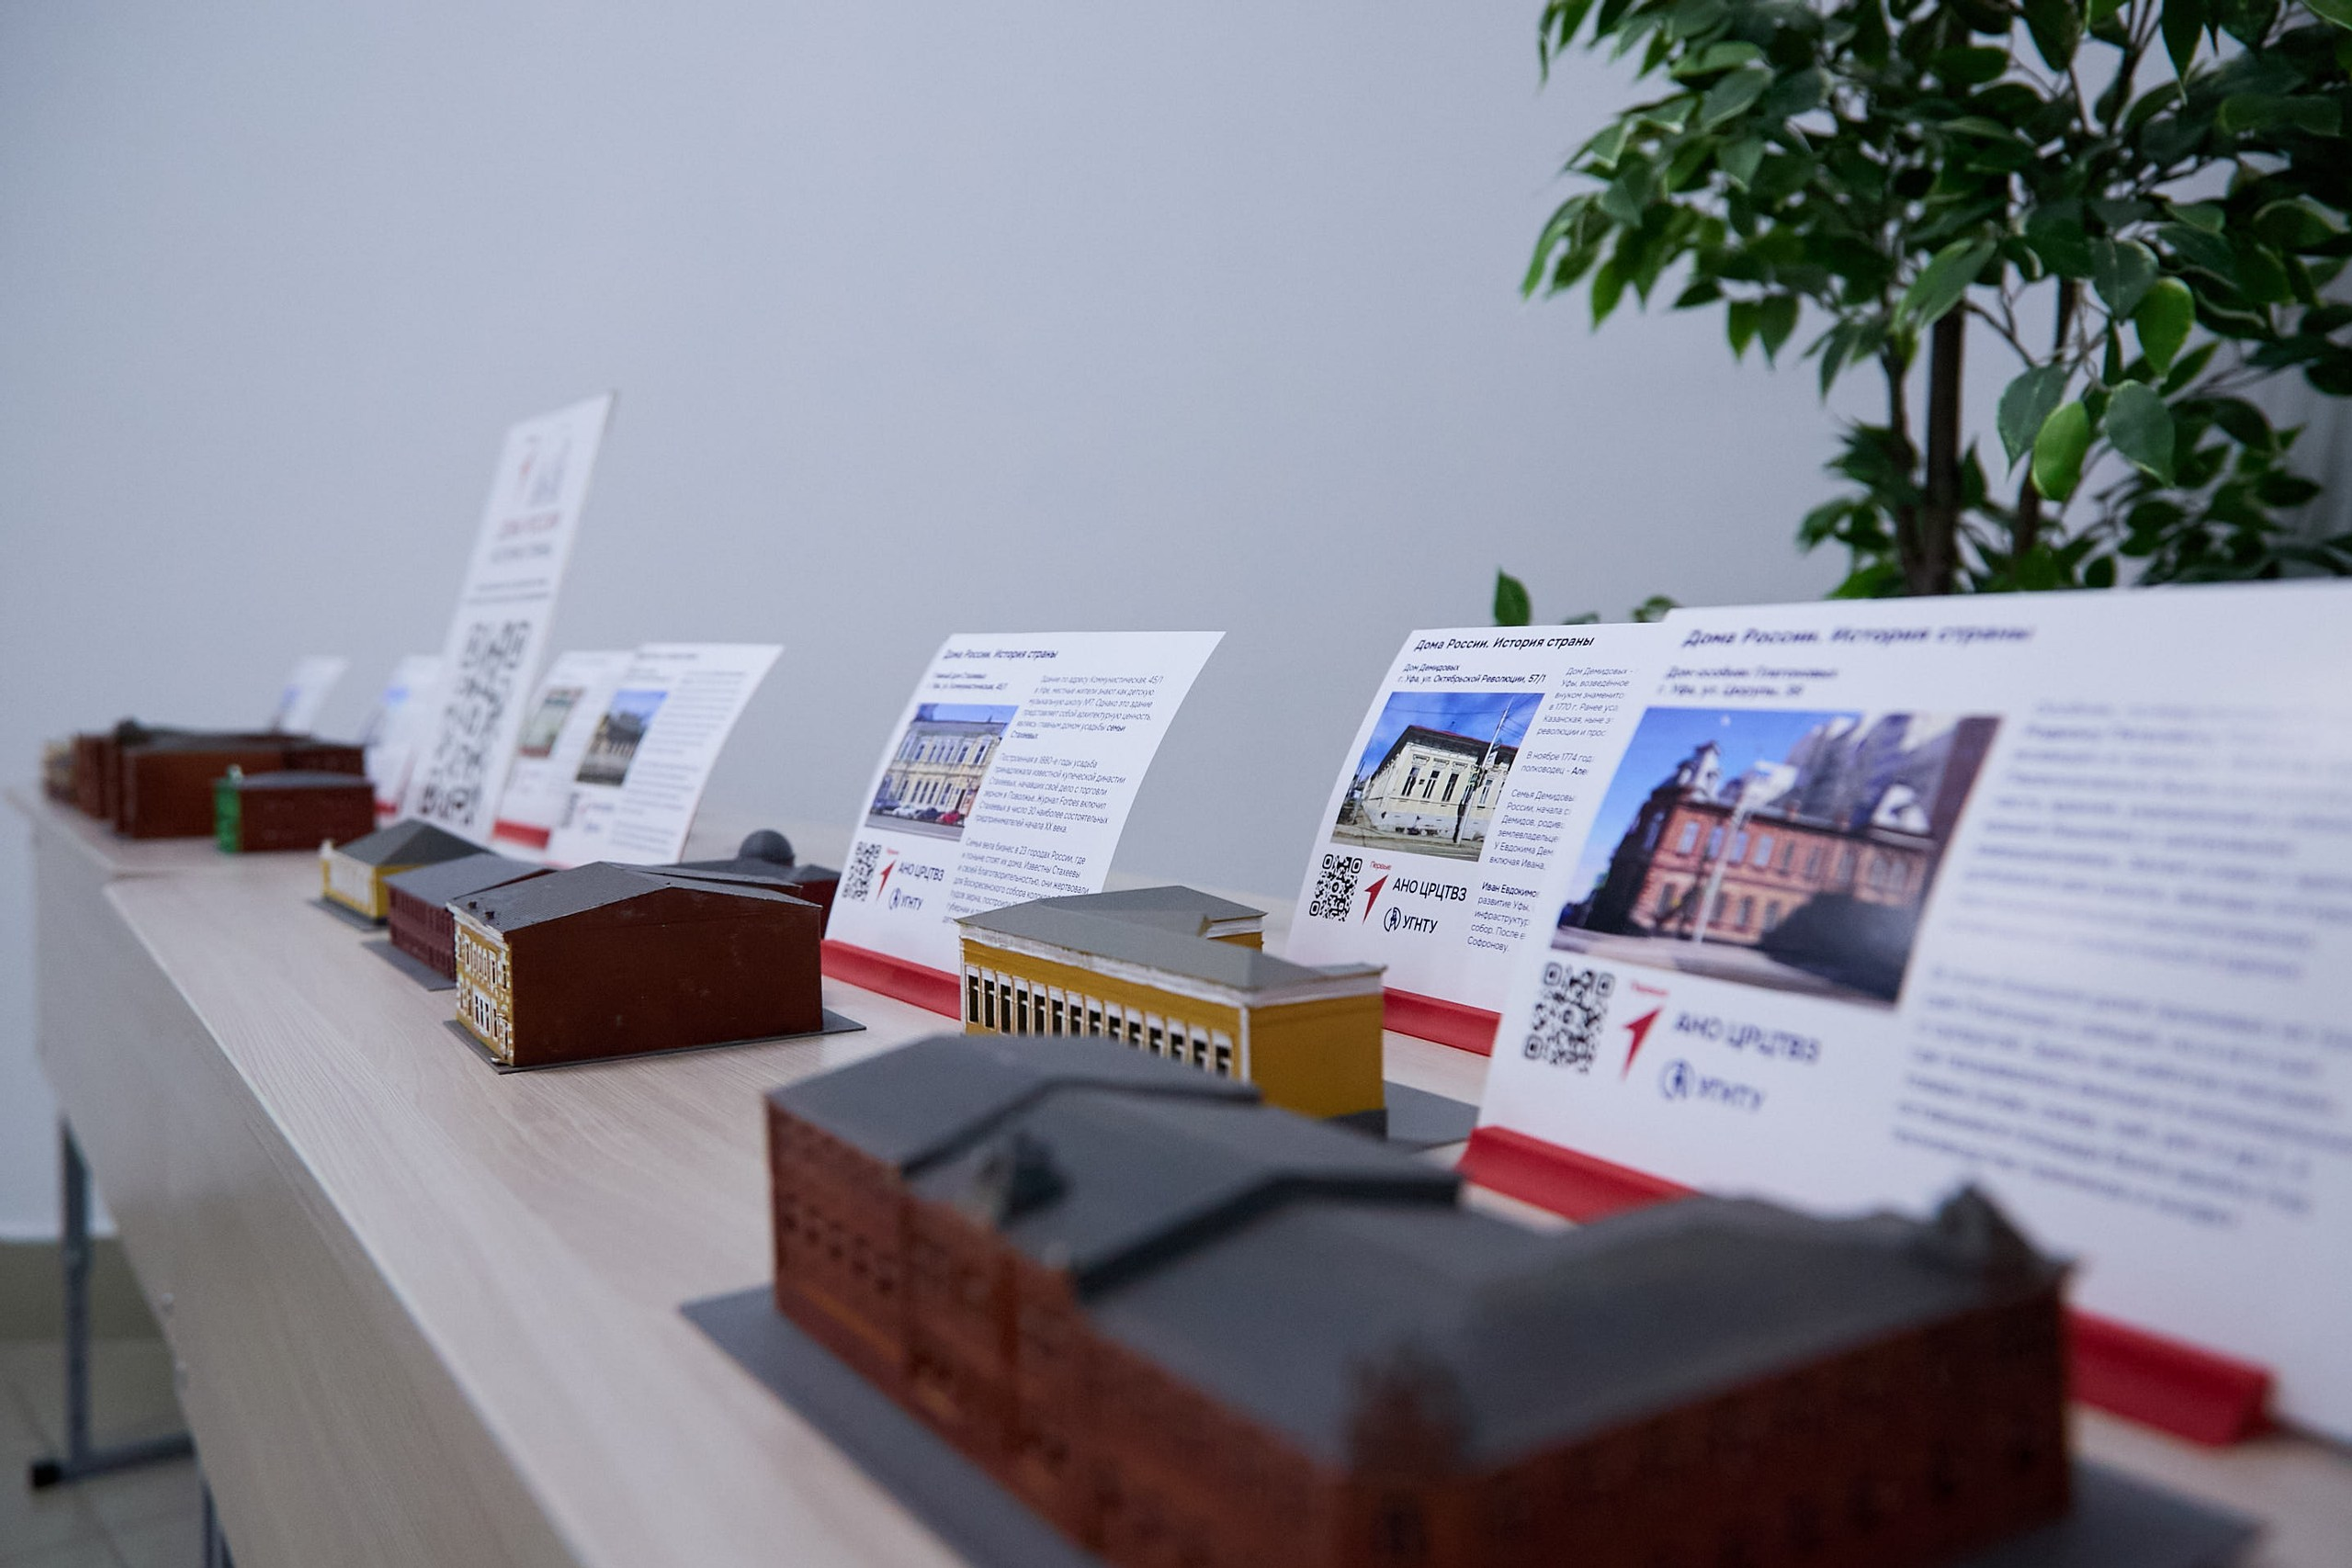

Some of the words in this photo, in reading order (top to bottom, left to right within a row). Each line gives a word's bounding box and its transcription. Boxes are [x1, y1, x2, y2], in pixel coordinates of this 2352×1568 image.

[1414, 639, 1444, 651] Дома
[1446, 638, 1488, 649] России.
[1492, 637, 1545, 650] История
[1546, 637, 1595, 649] страны
[994, 649, 1027, 660] История
[1027, 650, 1058, 660] страны
[1404, 663, 1419, 671] Дом
[1419, 663, 1460, 672] Демидовых
[1566, 667, 1582, 676] Дом
[1583, 667, 1628, 675] Демидовых
[1407, 675, 1419, 683] Уфа,
[1421, 676, 1431, 684] ул.
[1433, 674, 1481, 684] Октябрьской
[1482, 674, 1525, 684] Революции,
[1527, 674, 1546, 684] 57/1
[1126, 689, 1155, 697] детскую
[1555, 693, 1582, 701] внуком
[1095, 698, 1118, 707] Однако
[1555, 703, 1571, 711] 1770
[1579, 703, 1603, 711] Ранее
[1077, 711, 1122, 721] архитектурную
[1587, 729, 1607, 738] прос
[1526, 751, 1532, 760] В
[1533, 751, 1560, 761] ноябре
[1561, 752, 1577, 761] 1774
[1578, 755, 1594, 763] год
[1073, 760, 1098, 769] усадьба
[1521, 765, 1564, 775] полководец
[1570, 767, 1589, 775] Але
[1032, 769, 1062, 778] известной
[1062, 771, 1096, 782] купеческой
[1095, 775, 1126, 784] династии
[1058, 784, 1073, 794] дело
[1080, 786, 1108, 795] торговли
[1511, 789, 1534, 798] Семья
[1534, 791, 1576, 802] Демидовы
[1059, 797, 1080, 807] Forbes
[1080, 800, 1107, 809] включил
[1507, 802, 1534, 812] России,
[1536, 807, 1563, 815] начала
[1028, 806, 1036, 814] 30
[1036, 807, 1064, 819] наиболее
[1064, 813, 1108, 825] состоятельных
[1501, 815, 1536, 826] Демидов,
[1025, 820, 1045, 830] начала
[1498, 829, 1559, 843] землевладельце
[995, 841, 1014, 853] бизнес
[1020, 845, 1027, 855] 23
[1027, 849, 1050, 860] городах
[1051, 851, 1074, 863] России,
[1074, 855, 1087, 865] где
[1494, 841, 1499, 850] У
[1500, 842, 1535, 854] Евдокима
[1535, 846, 1554, 856] Дем
[899, 863, 914, 874] АНО
[1370, 861, 1392, 870] Первые
[1489, 856, 1520, 866] включая
[1521, 859, 1545, 871] Ивана,
[1023, 862, 1052, 874] Известны
[1052, 865, 1081, 879] Стахеевы
[978, 866, 1040, 886] благотворительностью,
[1040, 879, 1052, 888] они
[1052, 882, 1090, 895] жертвовали
[1482, 881, 1499, 892] Иван
[1006, 886, 1026, 897] собора
[1392, 877, 1419, 894] АНО
[1419, 881, 1467, 901] ЦРЦТВЗ
[900, 896, 924, 910] УГНТУ
[1477, 897, 1511, 908] развитие
[1513, 900, 1530, 911] Уфы,
[1402, 915, 1438, 933] УГНТУ
[1475, 910, 1530, 927] инфраструктур
[1471, 924, 1494, 934] собор.
[1496, 927, 1519, 939] После
[1467, 936, 1509, 953] Софронову.
[1673, 1012, 1723, 1042] АНО
[1698, 1076, 1767, 1111] УГНТУ
